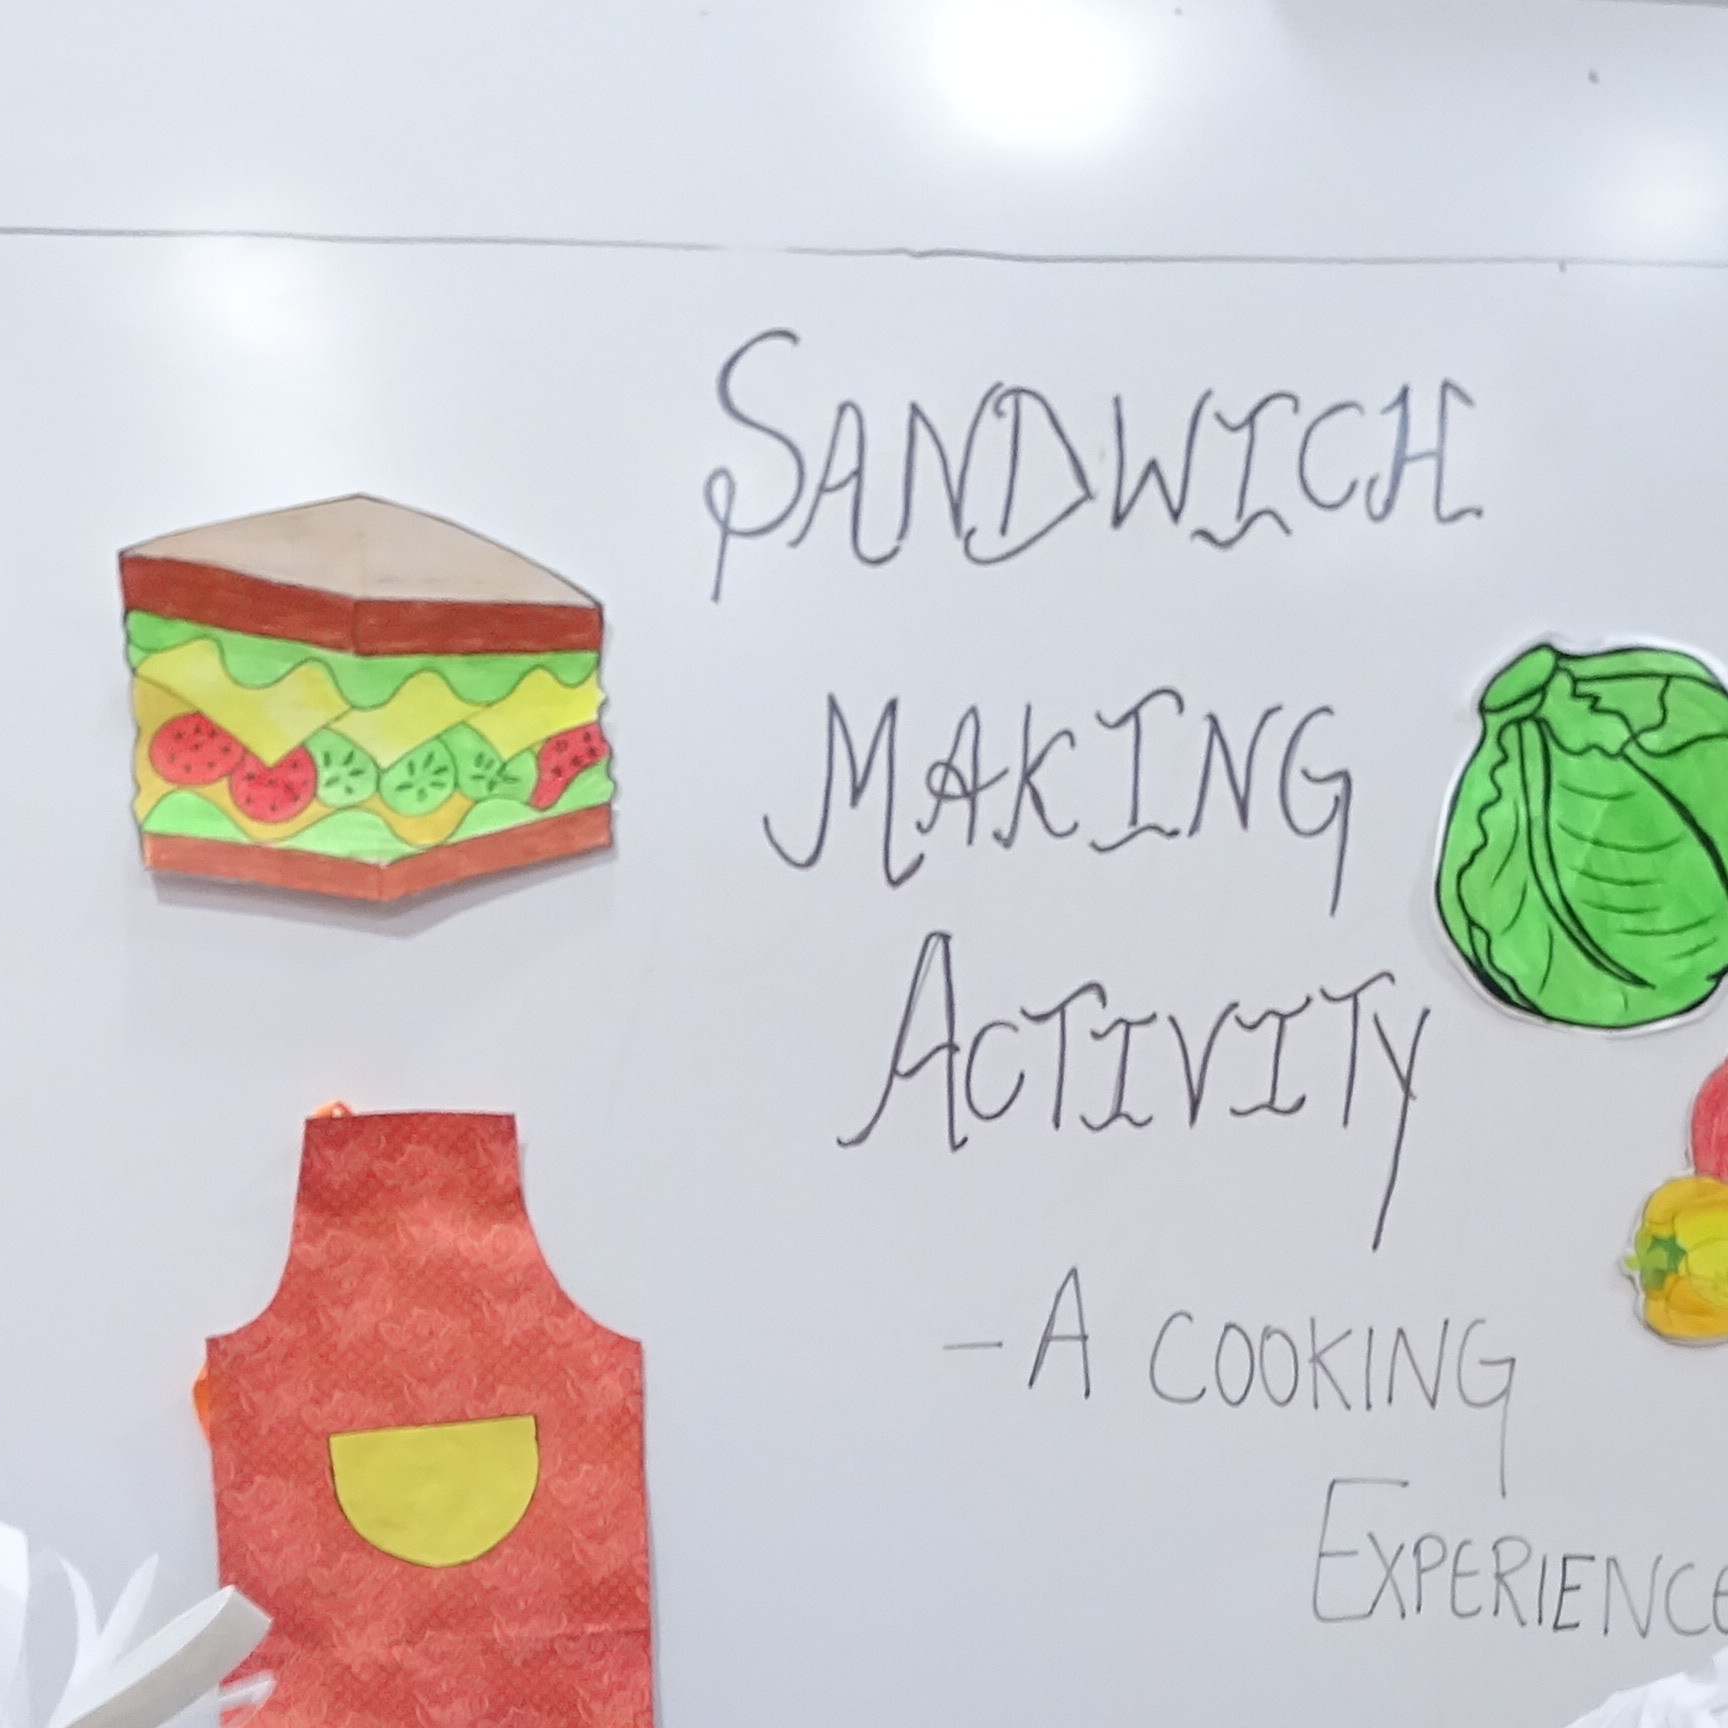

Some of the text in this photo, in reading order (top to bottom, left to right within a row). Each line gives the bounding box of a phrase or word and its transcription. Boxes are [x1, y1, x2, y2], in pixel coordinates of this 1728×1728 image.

[704, 328, 1483, 603] SANDWICH
[762, 686, 1353, 918] MAKING
[836, 930, 1431, 1252] ACTIVITY
[1149, 1310, 1516, 1498] COOKING
